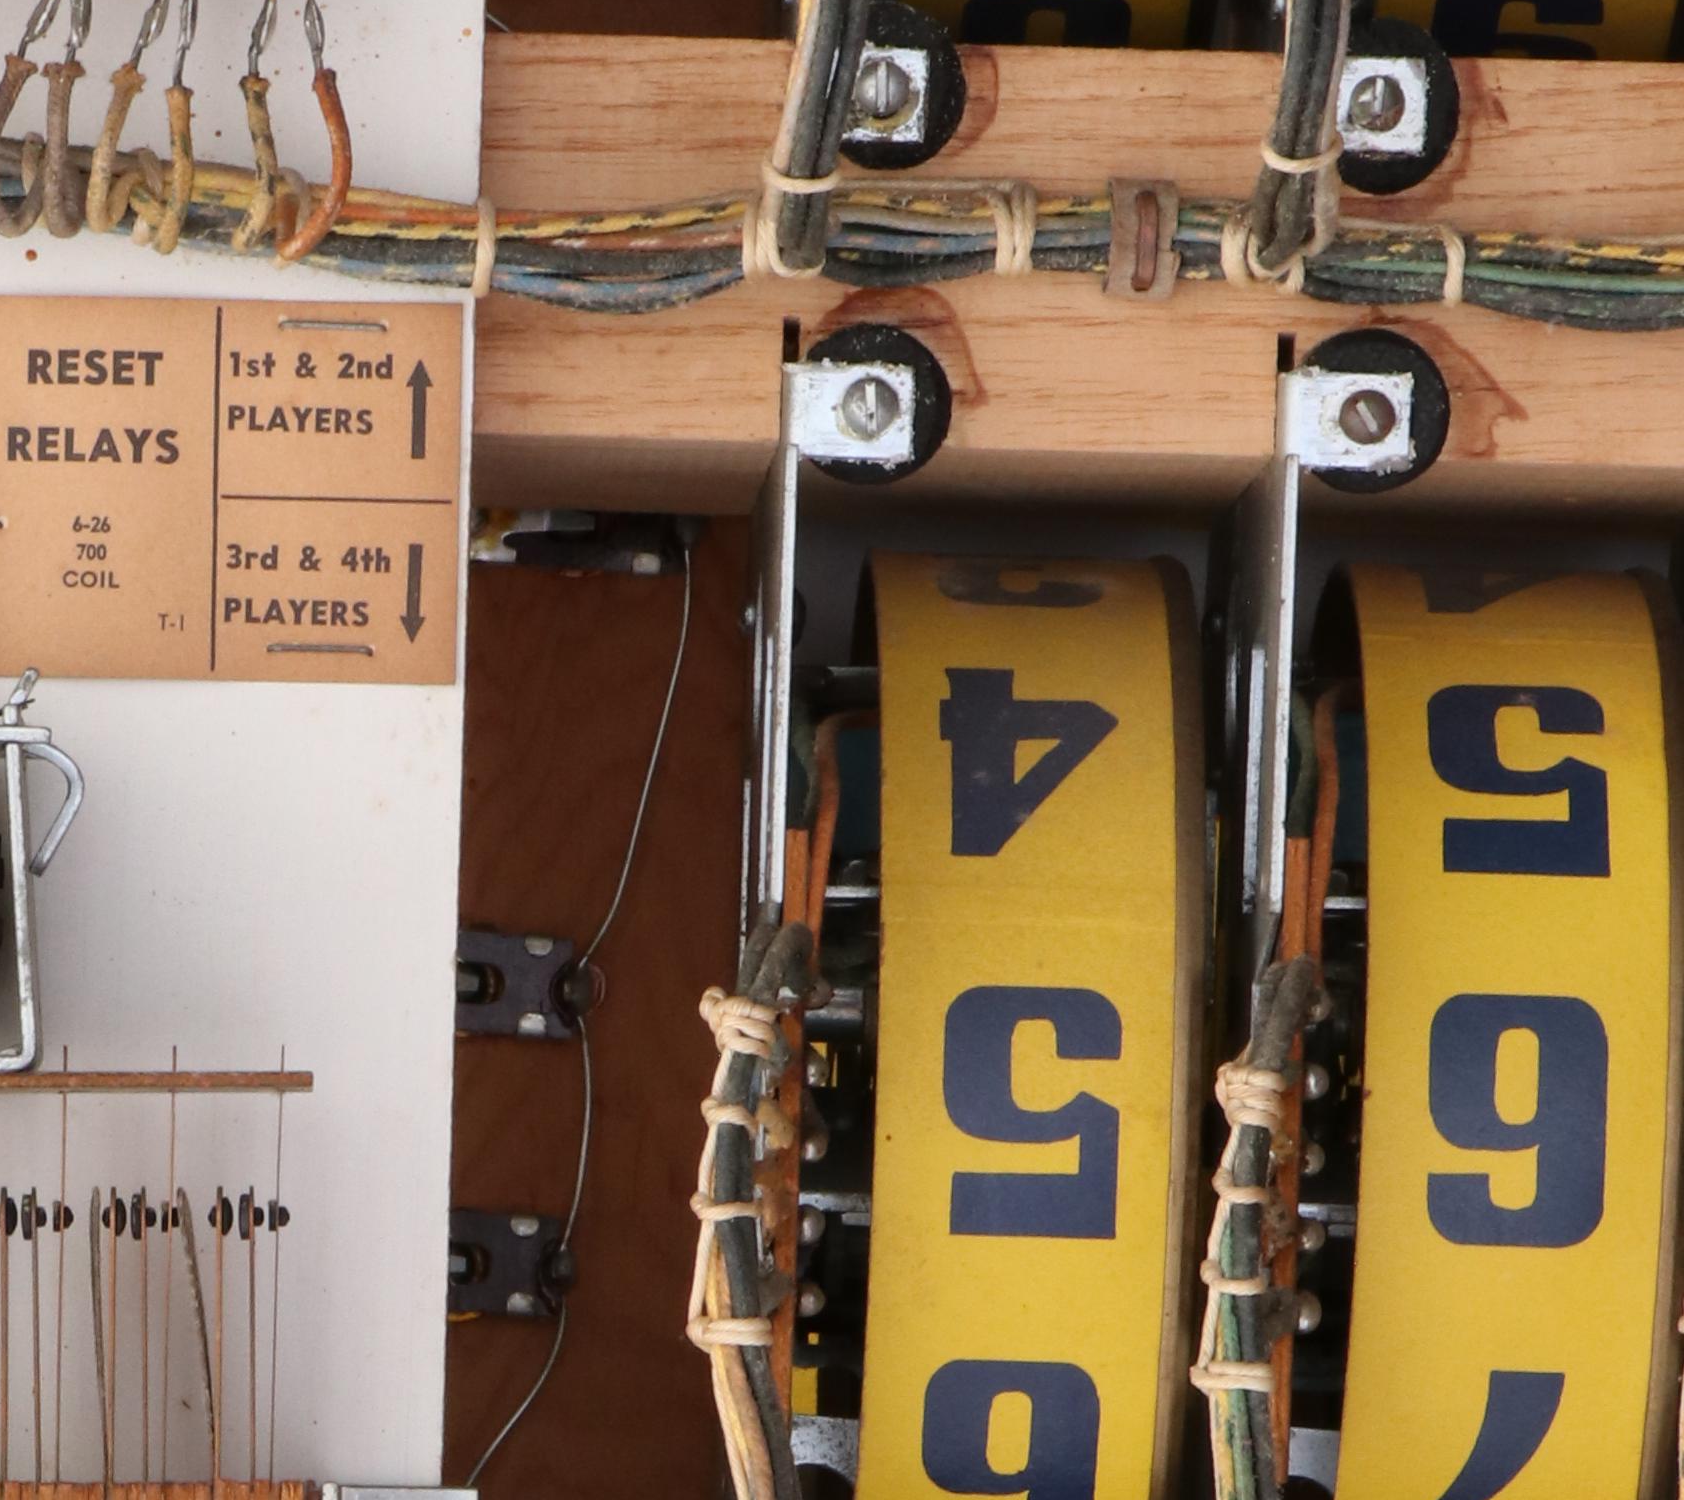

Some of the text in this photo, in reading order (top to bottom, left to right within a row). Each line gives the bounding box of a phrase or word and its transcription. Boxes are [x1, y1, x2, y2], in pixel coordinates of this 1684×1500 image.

[27, 348, 164, 387] RESET
[229, 351, 394, 380] 1st & 2nd
[227, 404, 374, 436] PLAYERS
[7, 426, 180, 465] RELAYS
[72, 515, 112, 534] 6-26
[75, 543, 108, 561] 700
[225, 543, 391, 574] 3rd & 4th
[62, 569, 120, 589] COIL
[223, 597, 370, 628] PLAYERS
[939, 668, 1118, 857] 4
[1428, 684, 1611, 877] 5
[943, 986, 1122, 1240] 5
